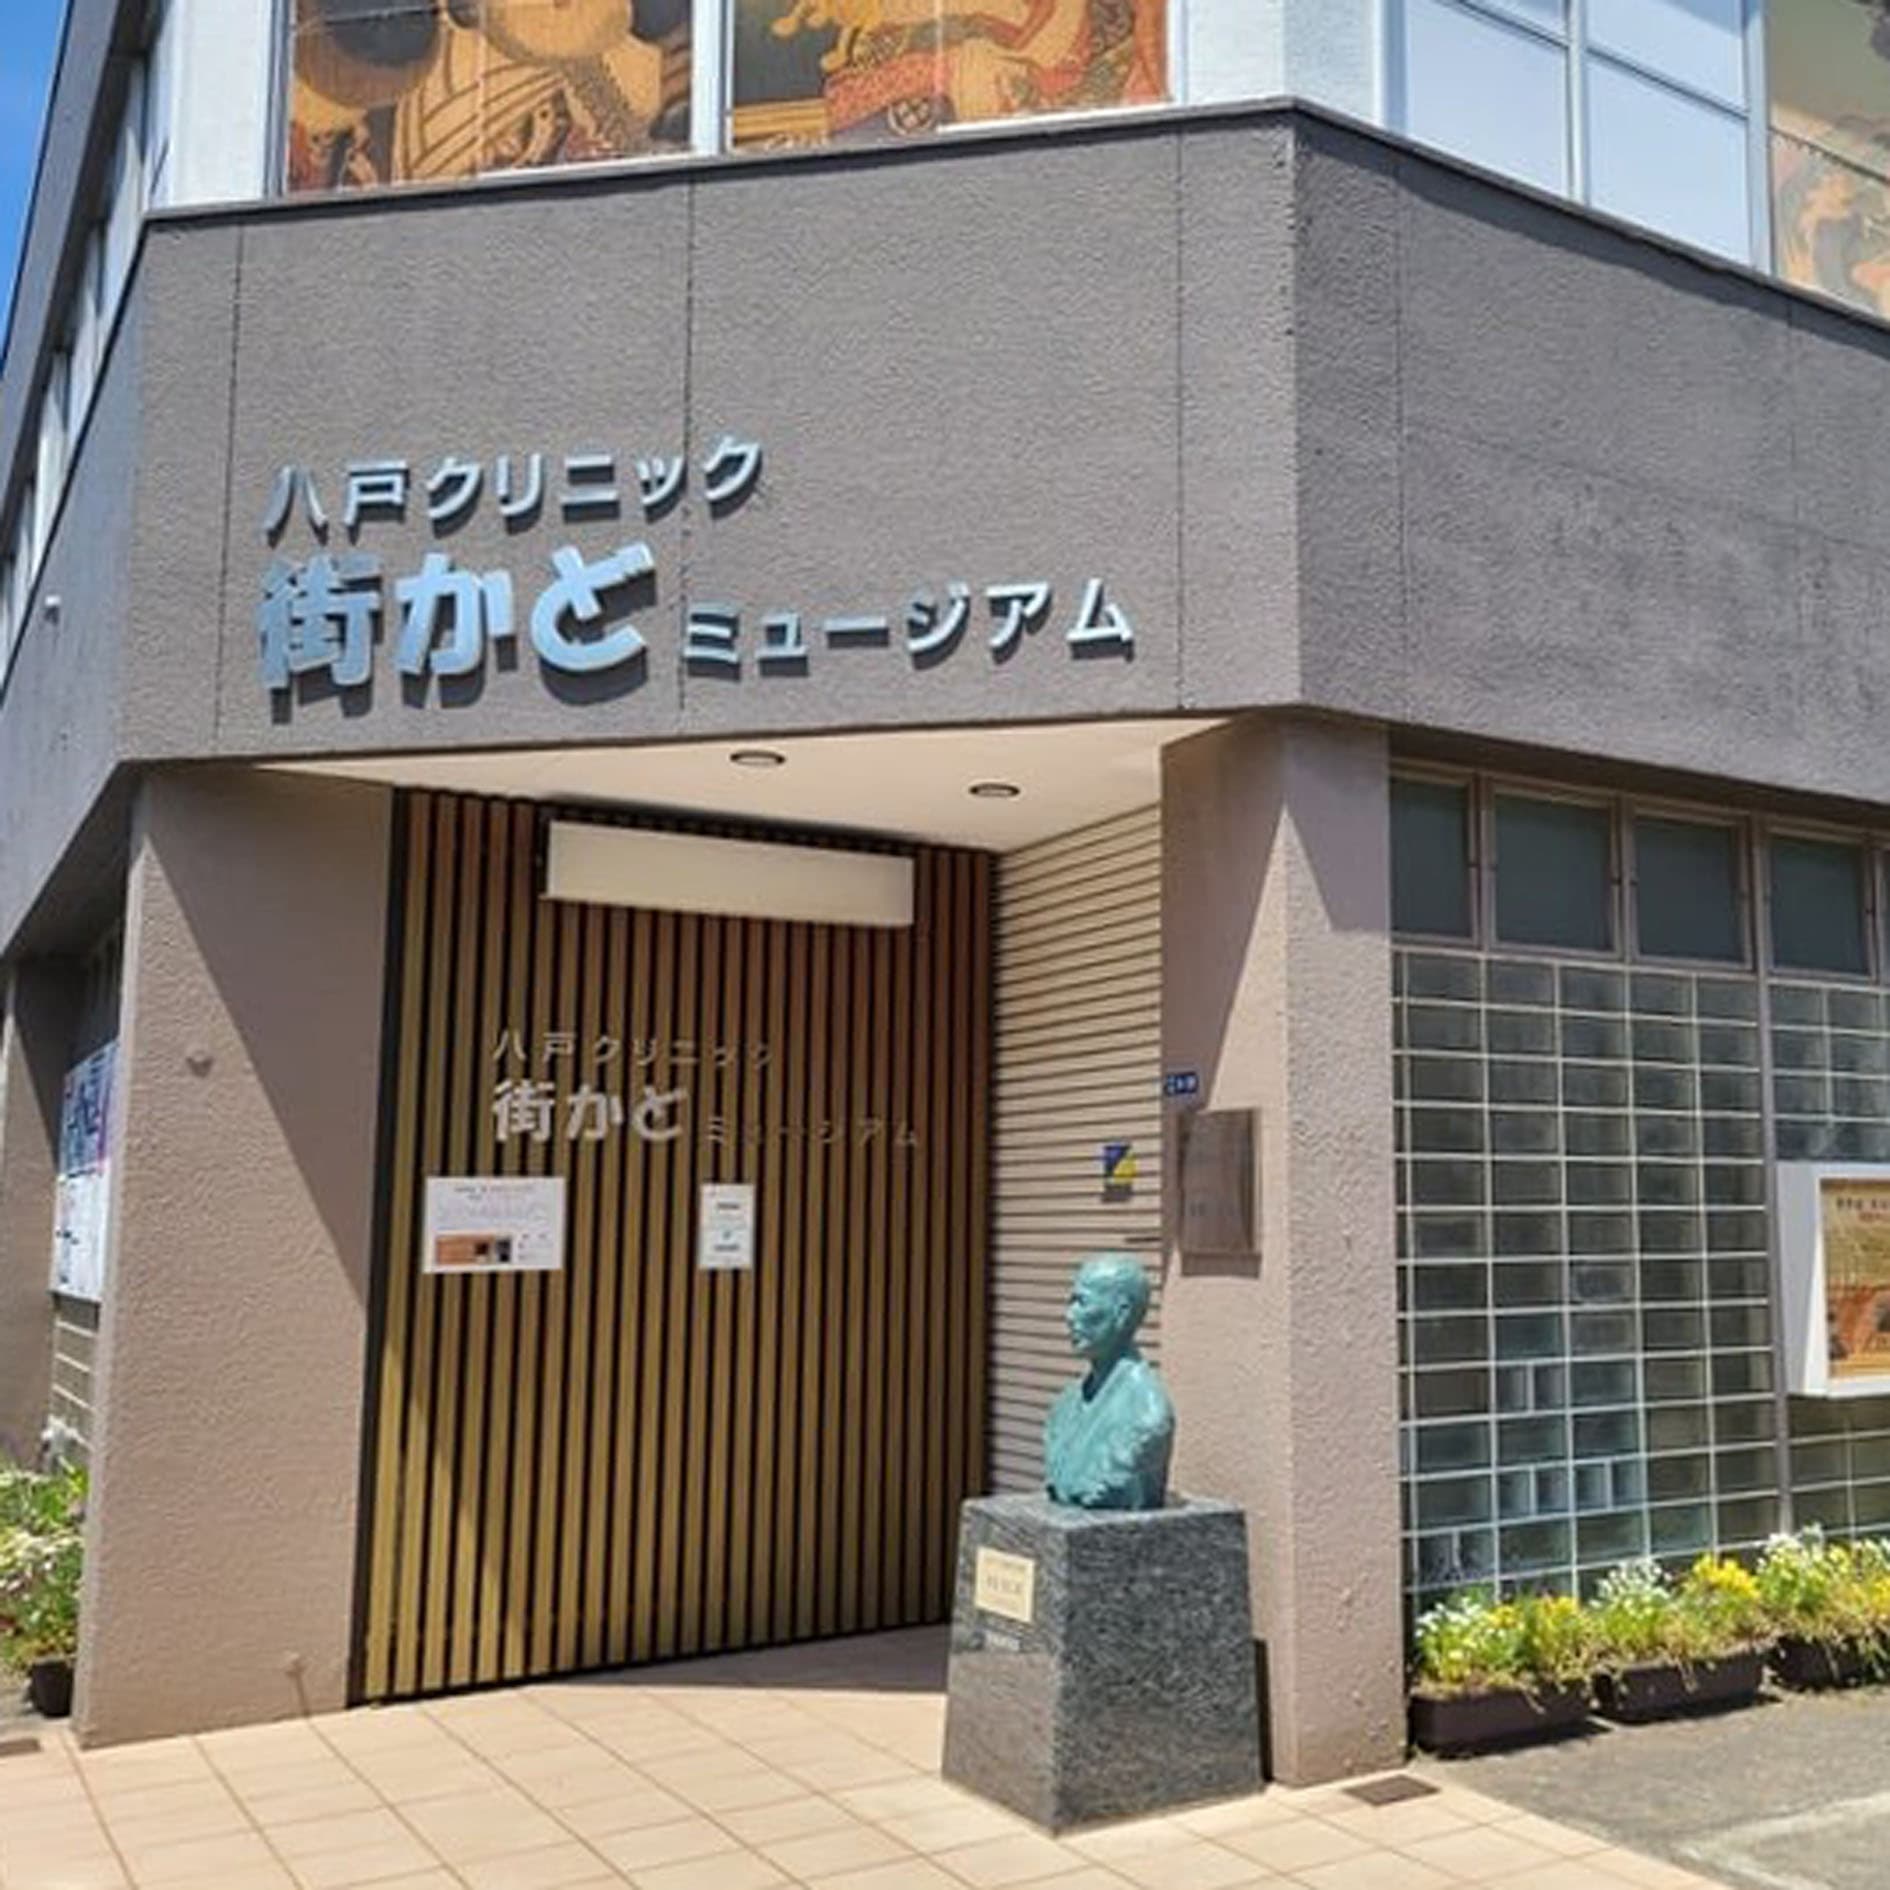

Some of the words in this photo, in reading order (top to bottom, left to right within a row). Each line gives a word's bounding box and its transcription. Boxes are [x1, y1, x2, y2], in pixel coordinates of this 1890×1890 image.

[262, 435, 763, 541] 八戸クリニック
